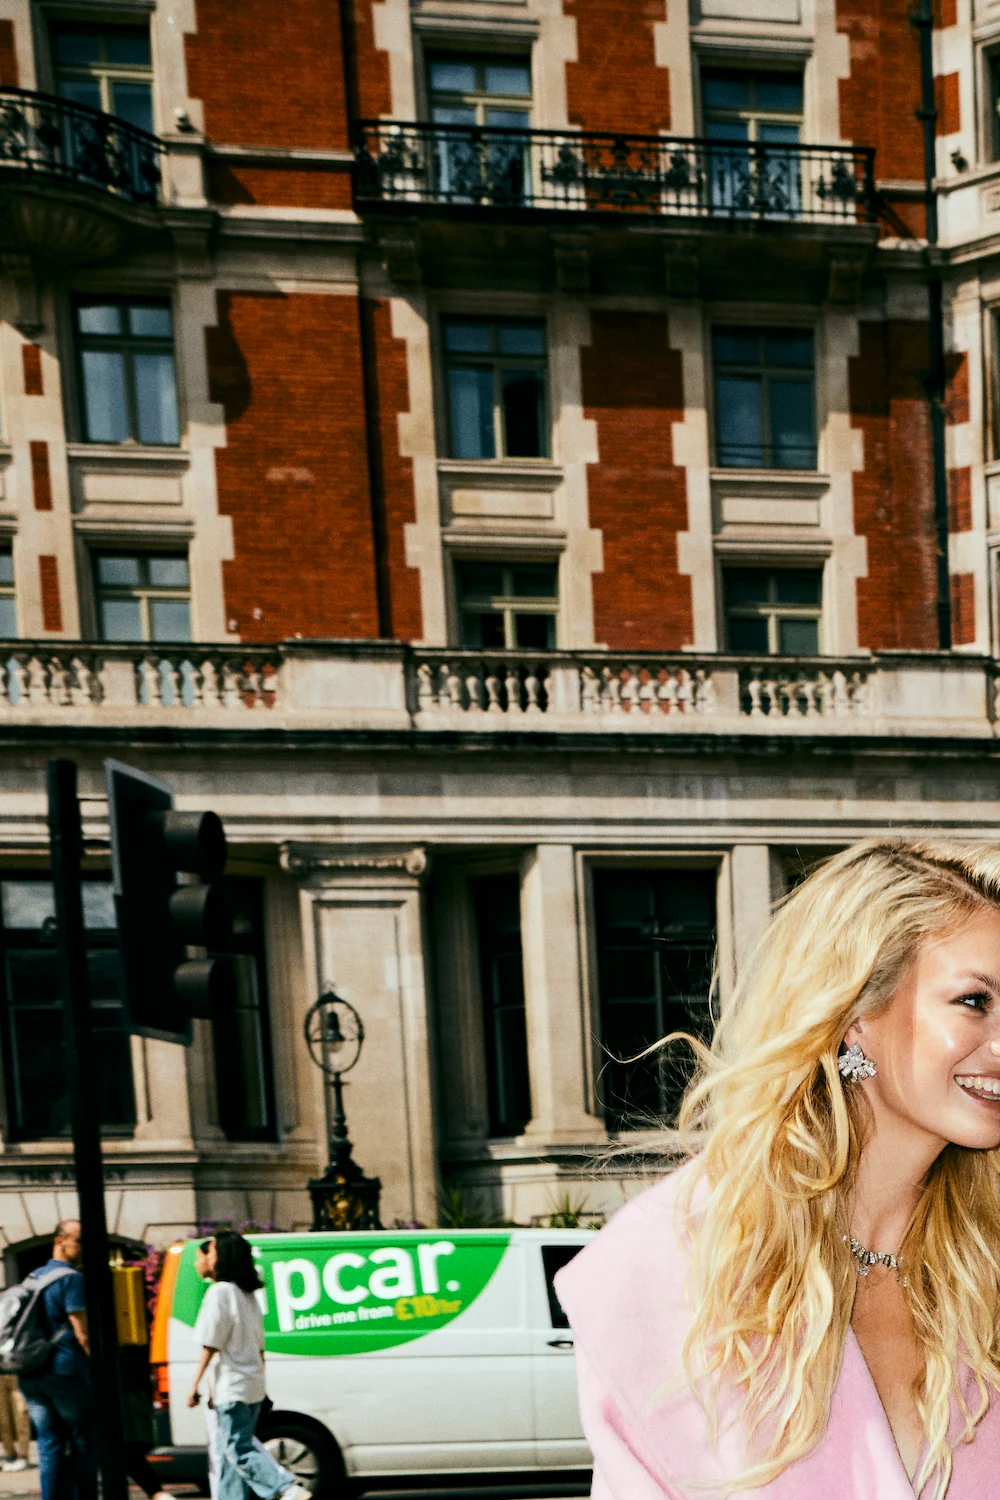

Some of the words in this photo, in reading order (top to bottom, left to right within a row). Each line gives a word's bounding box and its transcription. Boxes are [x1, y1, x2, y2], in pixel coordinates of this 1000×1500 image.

[296, 1313, 332, 1330] drive
[333, 1311, 358, 1324] me
[358, 1306, 393, 1321] from
